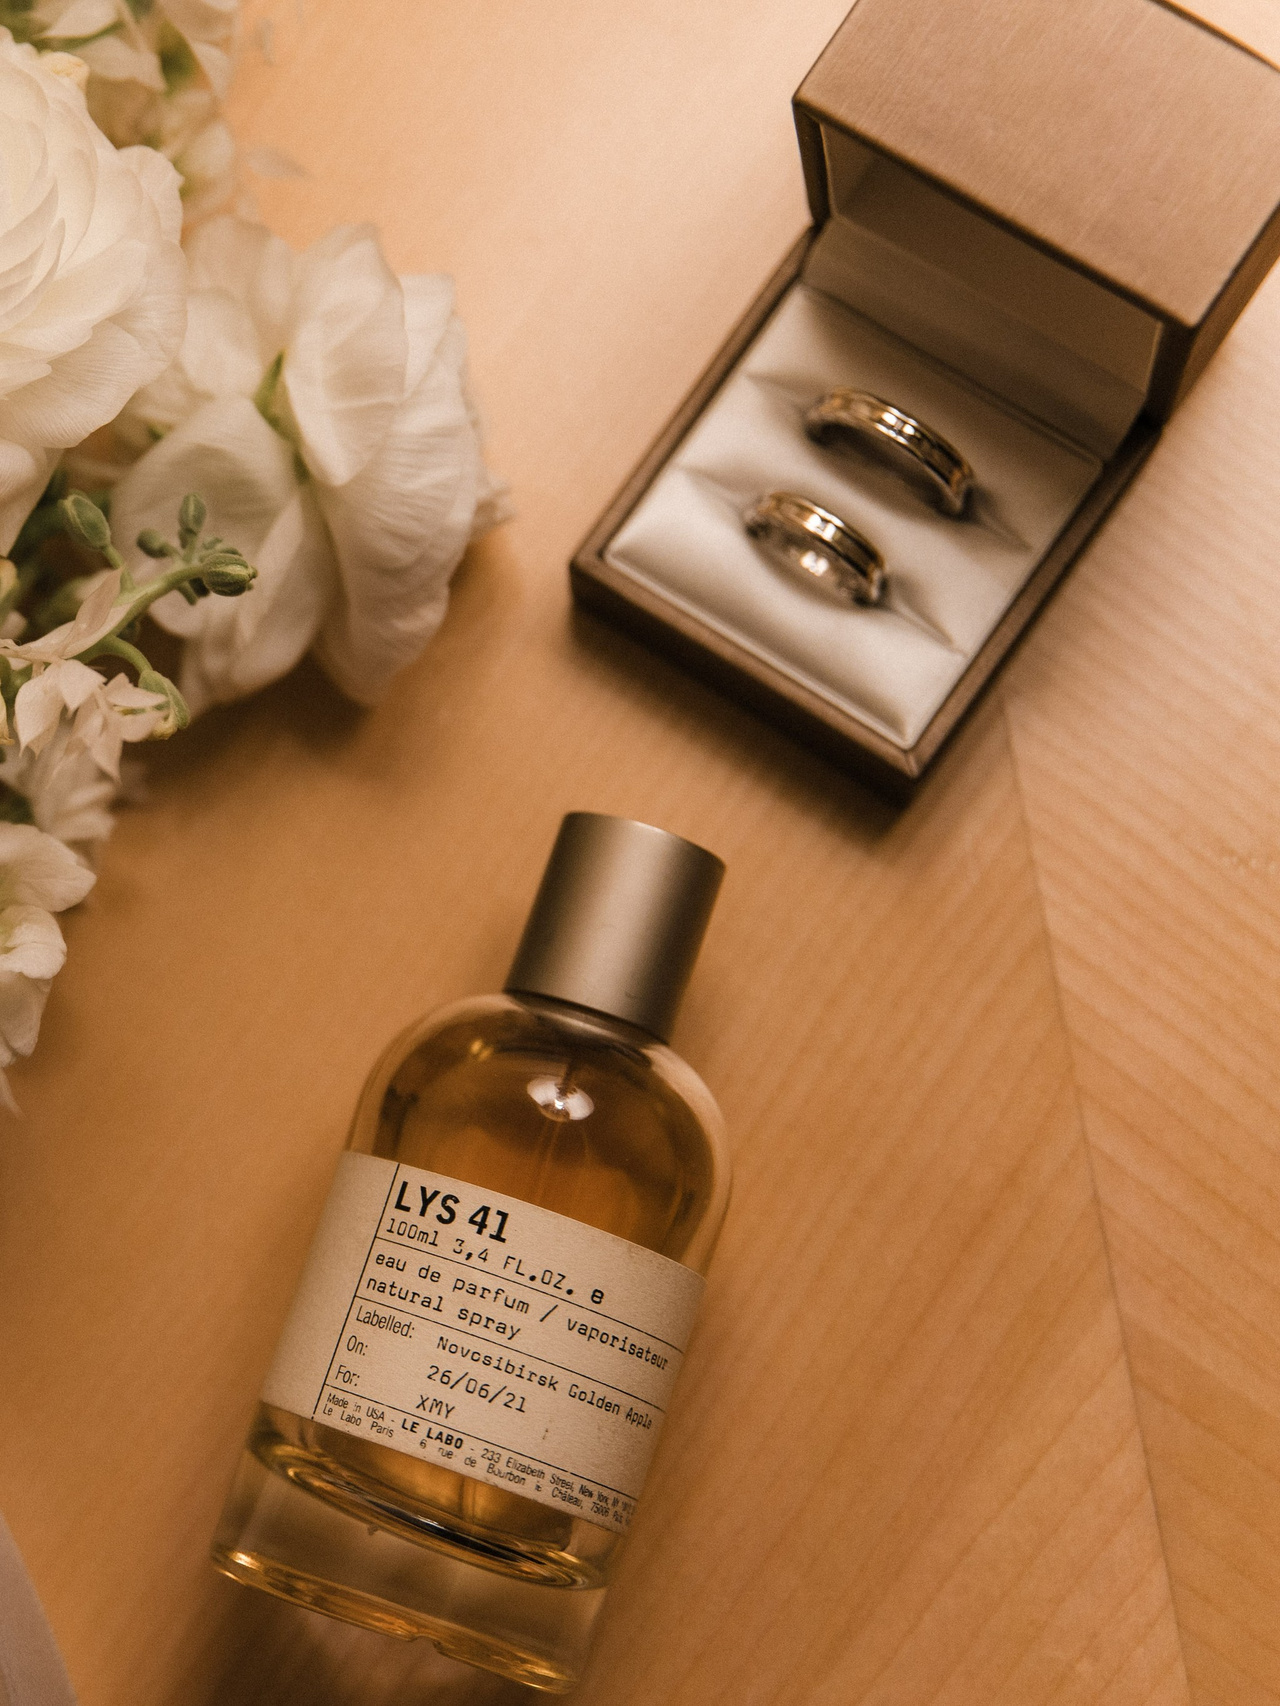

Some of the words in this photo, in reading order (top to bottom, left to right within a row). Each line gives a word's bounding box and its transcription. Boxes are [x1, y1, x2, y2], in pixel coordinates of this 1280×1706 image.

[386, 1218, 439, 1247] 100ml
[452, 1238, 489, 1262] 3,4
[394, 1181, 460, 1225] LYS
[468, 1205, 509, 1243] 41
[366, 1277, 443, 1312] natural
[457, 1307, 521, 1340] spray
[375, 1253, 407, 1273] eau
[418, 1265, 441, 1283] de
[452, 1278, 530, 1314] parfum
[566, 1317, 669, 1370] vaporisateur
[335, 1364, 360, 1387] For:
[415, 1394, 456, 1419] XMY
[346, 1335, 369, 1356] On:
[426, 1365, 526, 1413] 26/06/21
[356, 1305, 415, 1338] Labelled:
[568, 1384, 620, 1416] Golden
[625, 1407, 652, 1430] Apple
[322, 1403, 333, 1416] Le
[340, 1410, 362, 1427] Labo
[370, 1420, 394, 1438] Paris
[464, 1455, 477, 1468] de
[326, 1393, 349, 1409] Made
[352, 1402, 361, 1413] in
[366, 1406, 385, 1423] USA
[401, 1418, 420, 1434] LE
[426, 1427, 464, 1450] LABO
[481, 1448, 502, 1463] 233
[505, 1456, 545, 1480] Elizabeth
